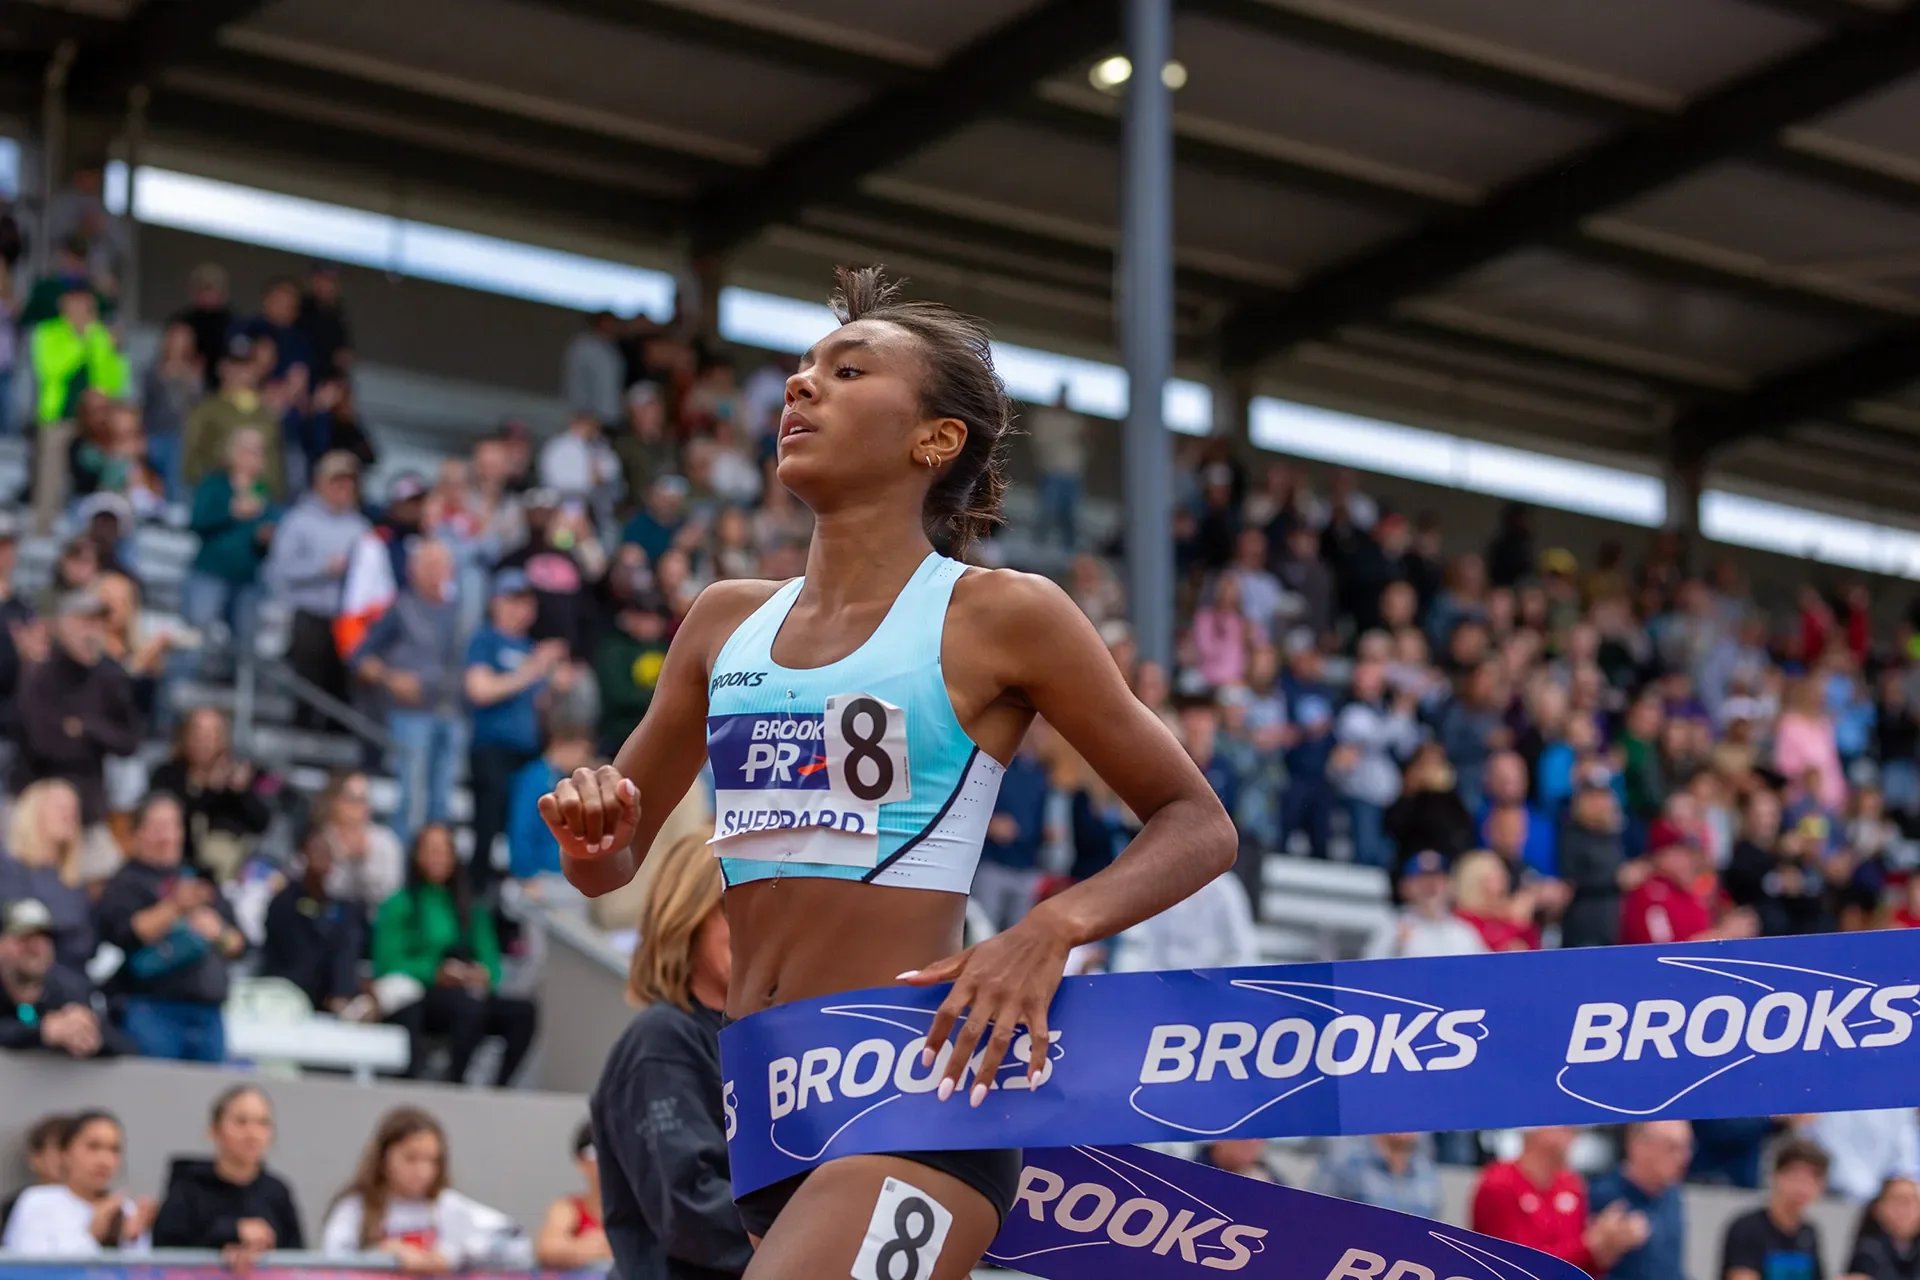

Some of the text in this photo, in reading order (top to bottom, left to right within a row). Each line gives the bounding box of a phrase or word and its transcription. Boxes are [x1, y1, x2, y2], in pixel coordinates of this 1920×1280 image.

[739, 742, 801, 782] PR
[751, 719, 825, 740] BROOK
[841, 698, 895, 801] 8
[1138, 1008, 1487, 1084] BROOKS
[1565, 984, 1920, 1064] BROOKS
[876, 1196, 935, 1280] 8
[1009, 1165, 1269, 1271] ROOKS
